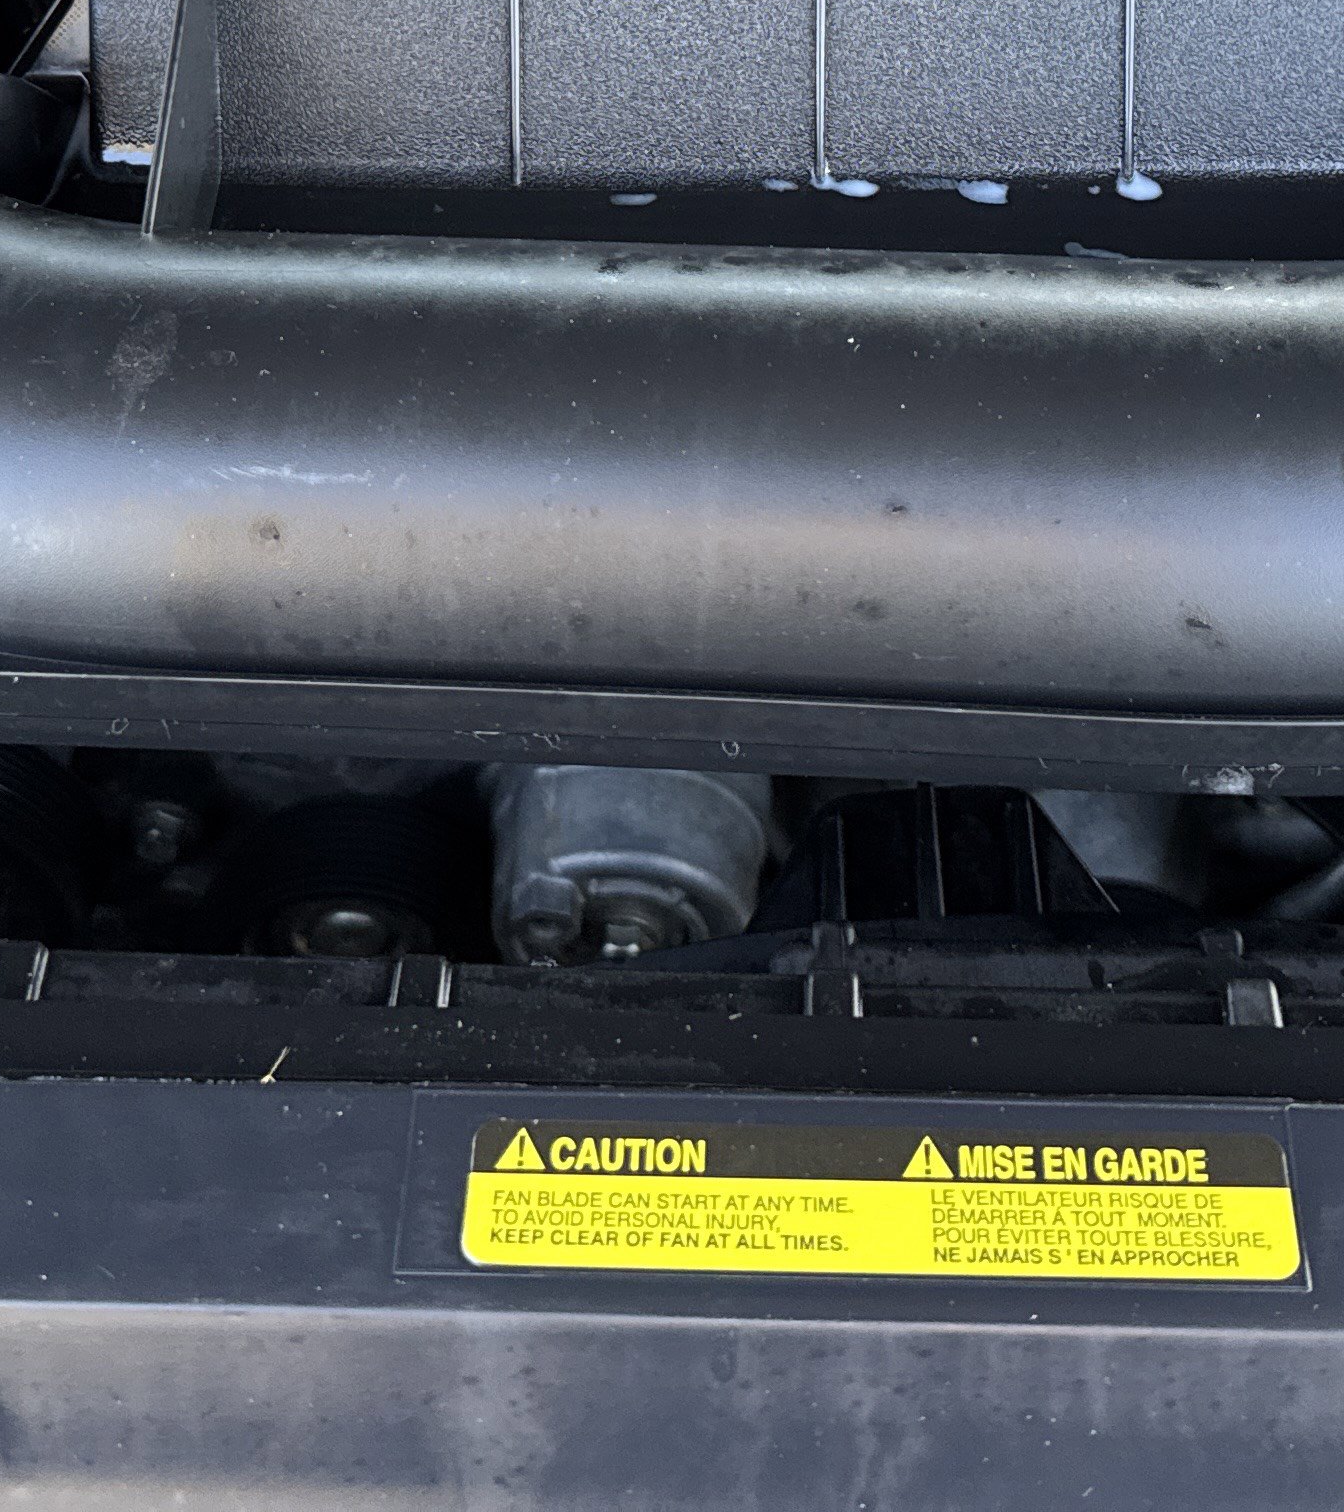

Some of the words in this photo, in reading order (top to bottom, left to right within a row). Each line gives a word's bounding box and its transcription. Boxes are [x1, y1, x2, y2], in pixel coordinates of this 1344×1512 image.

[550, 1136, 707, 1173] CAUTION
[958, 1144, 1036, 1180] MISE
[1043, 1146, 1087, 1181] EN
[1094, 1147, 1210, 1183] GARDE
[492, 1190, 531, 1206] FAN
[537, 1191, 602, 1208] BLADE
[608, 1192, 651, 1209] CAN
[657, 1193, 721, 1210] START
[725, 1194, 750, 1211] AT
[753, 1195, 795, 1212] ANY
[800, 1196, 855, 1214] TIME.
[930, 1189, 955, 1207] LE
[962, 1191, 1102, 1209] VENTILATEUR
[1109, 1193, 1190, 1211] RISQUE
[1194, 1193, 1223, 1210] DE
[492, 1209, 519, 1225] TO
[523, 1209, 583, 1227] AVOID
[590, 1211, 699, 1229] PERSONAL
[705, 1214, 781, 1233] INJURY,
[1070, 1210, 1125, 1228] TOUT
[1137, 1211, 1227, 1229] MOMENT.
[490, 1228, 543, 1245] KEEP
[550, 1230, 619, 1248] CLEAR
[626, 1231, 654, 1248] OF
[659, 1232, 699, 1249] FAN
[704, 1233, 729, 1249] AT
[736, 1234, 775, 1250] ALL
[780, 1235, 849, 1252] TIMES.
[932, 1227, 990, 1245] POUR
[996, 1224, 1071, 1246] ÉVITER
[1076, 1230, 1146, 1248] TOUTE
[1153, 1231, 1273, 1251] BLESSURE,
[933, 1248, 960, 1263] NE
[966, 1248, 1043, 1264] JAMAIS
[1108, 1251, 1240, 1267] APPROCHER
